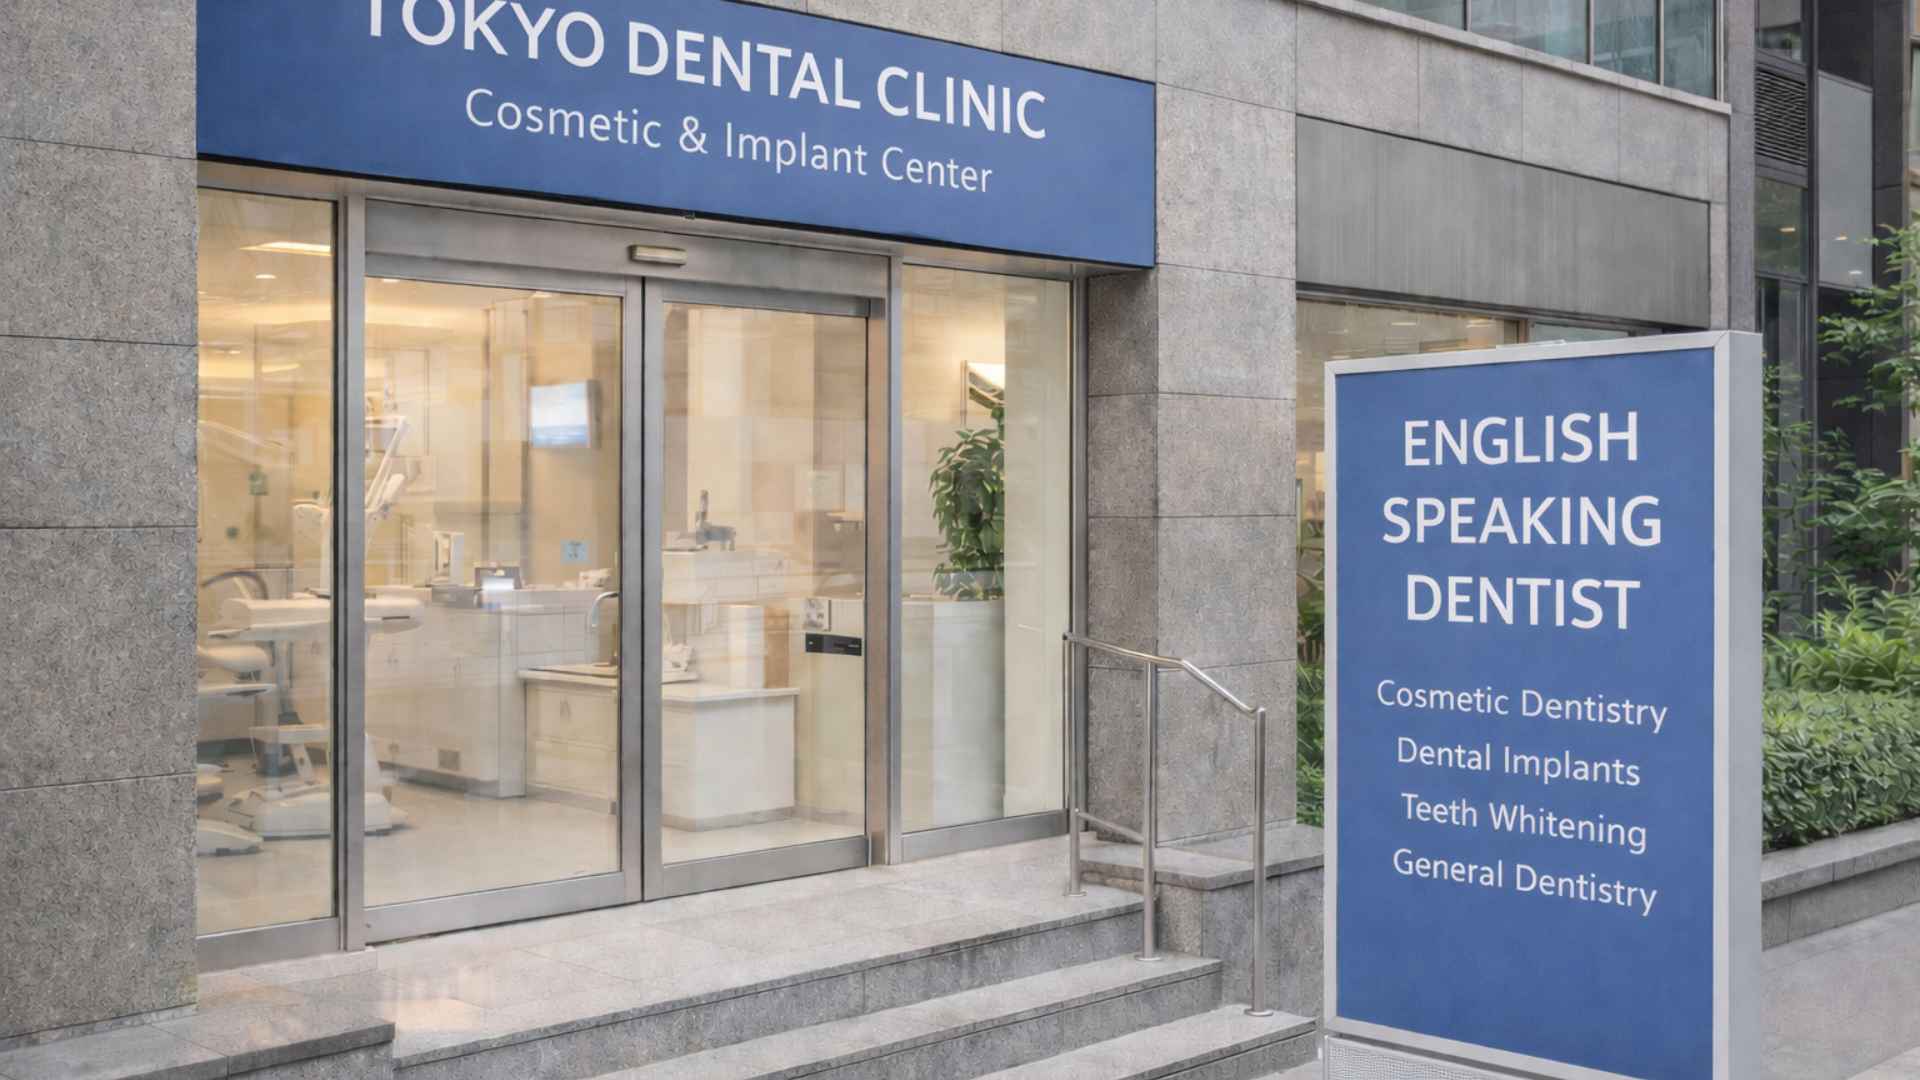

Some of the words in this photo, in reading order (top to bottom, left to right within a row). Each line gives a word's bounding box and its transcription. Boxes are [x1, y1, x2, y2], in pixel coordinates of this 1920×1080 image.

[628, 21, 861, 110] DENTAL
[876, 66, 1047, 140] CLINIC
[465, 88, 662, 149] Cosmetic
[679, 115, 708, 155] &
[726, 122, 868, 176] Implant
[881, 146, 993, 194] Center
[1404, 411, 1638, 467] ENGLISH
[1383, 495, 1661, 547] SPEAKING
[1407, 574, 1641, 631] DENTIST
[1377, 679, 1509, 716] Cosmetic
[1521, 689, 1668, 735] Dentistry
[1397, 736, 1491, 772] Dental
[1504, 746, 1641, 787] Implants
[1401, 792, 1478, 828] Teeth
[1489, 802, 1646, 856] Whitening
[1393, 848, 1503, 888] General
[1516, 863, 1657, 918] Dentistry
